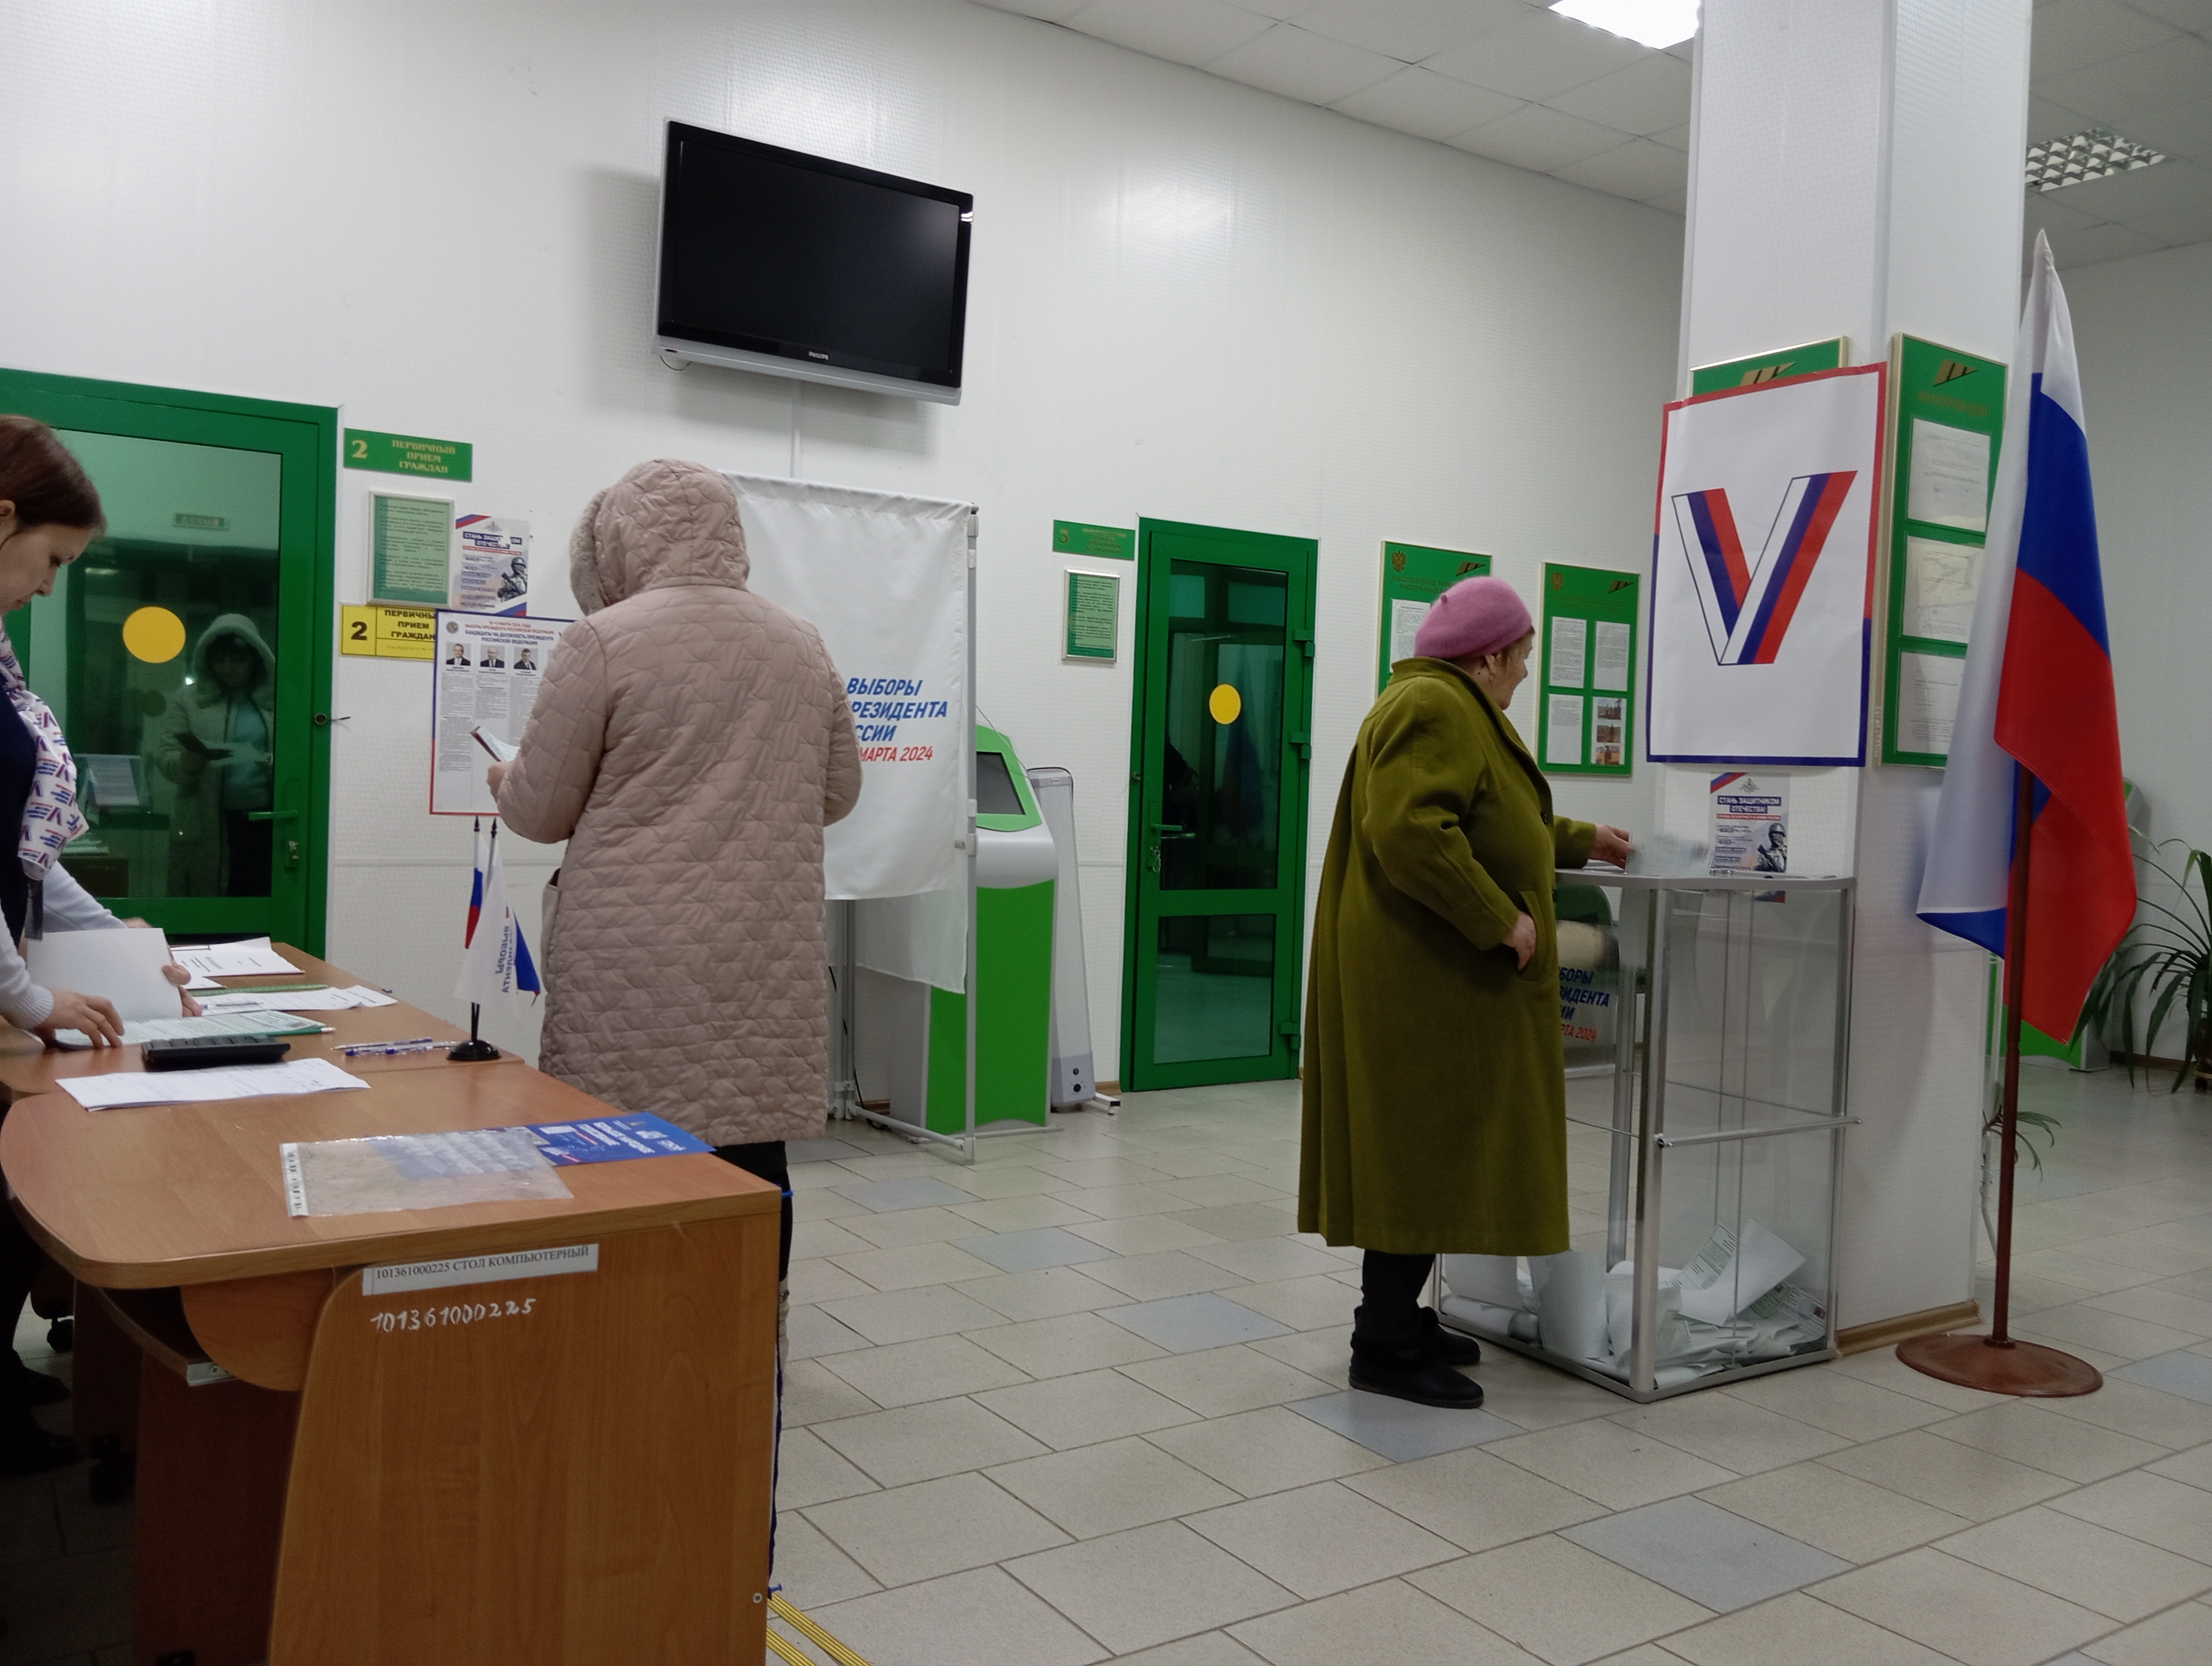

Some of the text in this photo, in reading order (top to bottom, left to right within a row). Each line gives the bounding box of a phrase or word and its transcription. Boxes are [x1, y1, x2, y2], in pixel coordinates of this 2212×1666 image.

[352, 440, 368, 458] 2
[393, 440, 455, 454] ПЕРВИЧНЫЙ
[407, 452, 441, 463] ПРИЕМ
[399, 461, 448, 473] ГРАЖДАН
[385, 610, 436, 619] ПЕРВИЧНЫ
[351, 621, 368, 641] 2
[398, 621, 429, 630] ПРИЕМ
[391, 631, 436, 640] ГРАЖДАН
[847, 678, 923, 696] ВЫБОРЫ
[851, 701, 948, 721] РЕЗИДЕНТА
[860, 746, 934, 761] МАРТА 2024
[1559, 967, 1594, 985] БОРЫ
[376, 1245, 589, 1280] 101361000225 СТОЛ КОМПЬЮТЕРНЫЙ
[370, 1298, 536, 1333] 101361000225
